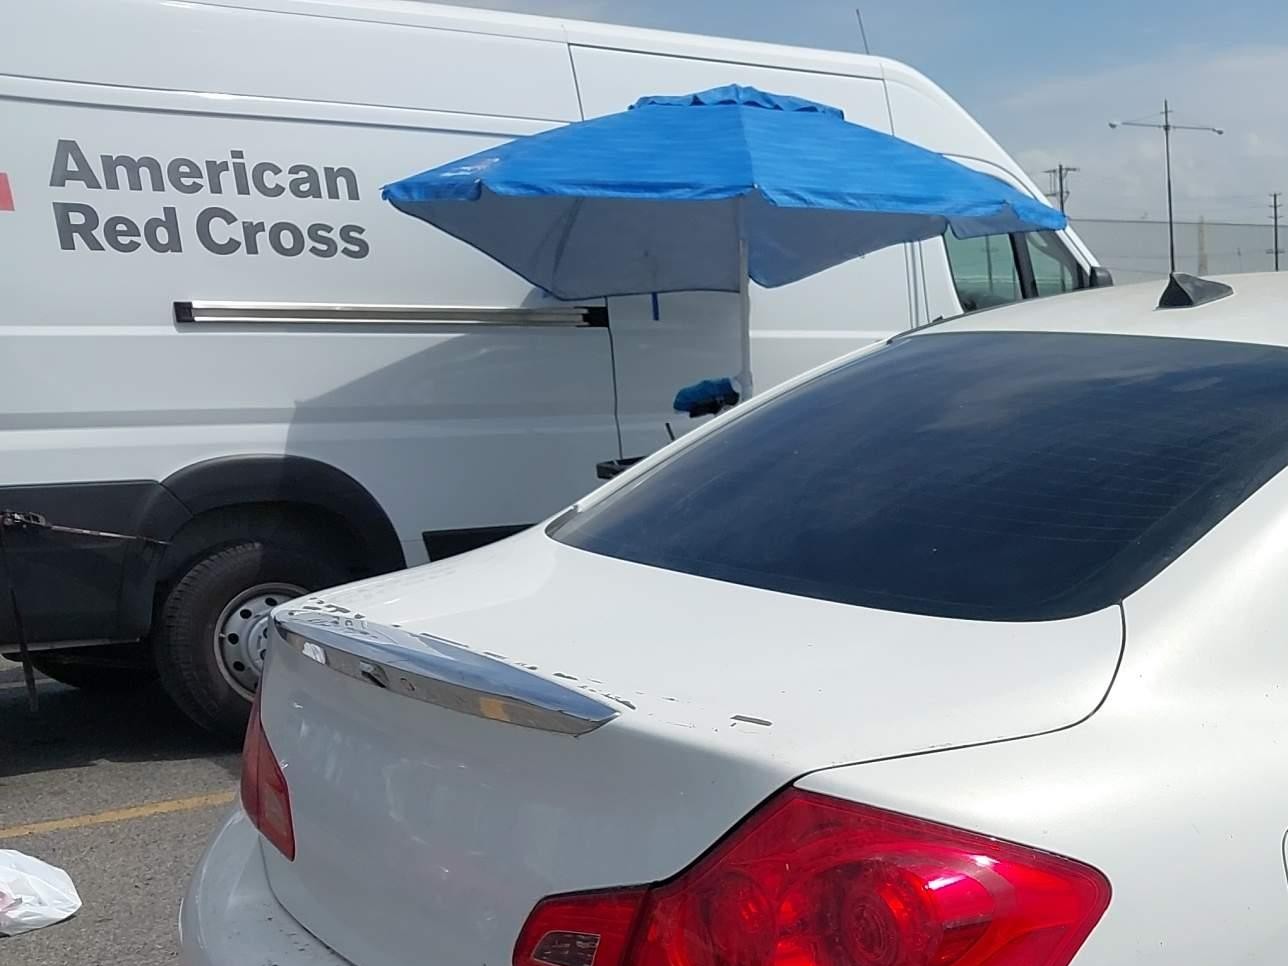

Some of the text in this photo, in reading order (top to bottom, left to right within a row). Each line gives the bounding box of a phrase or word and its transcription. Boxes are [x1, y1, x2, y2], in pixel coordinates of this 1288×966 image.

[49, 139, 361, 201] American
[52, 201, 370, 260] Red Cross
